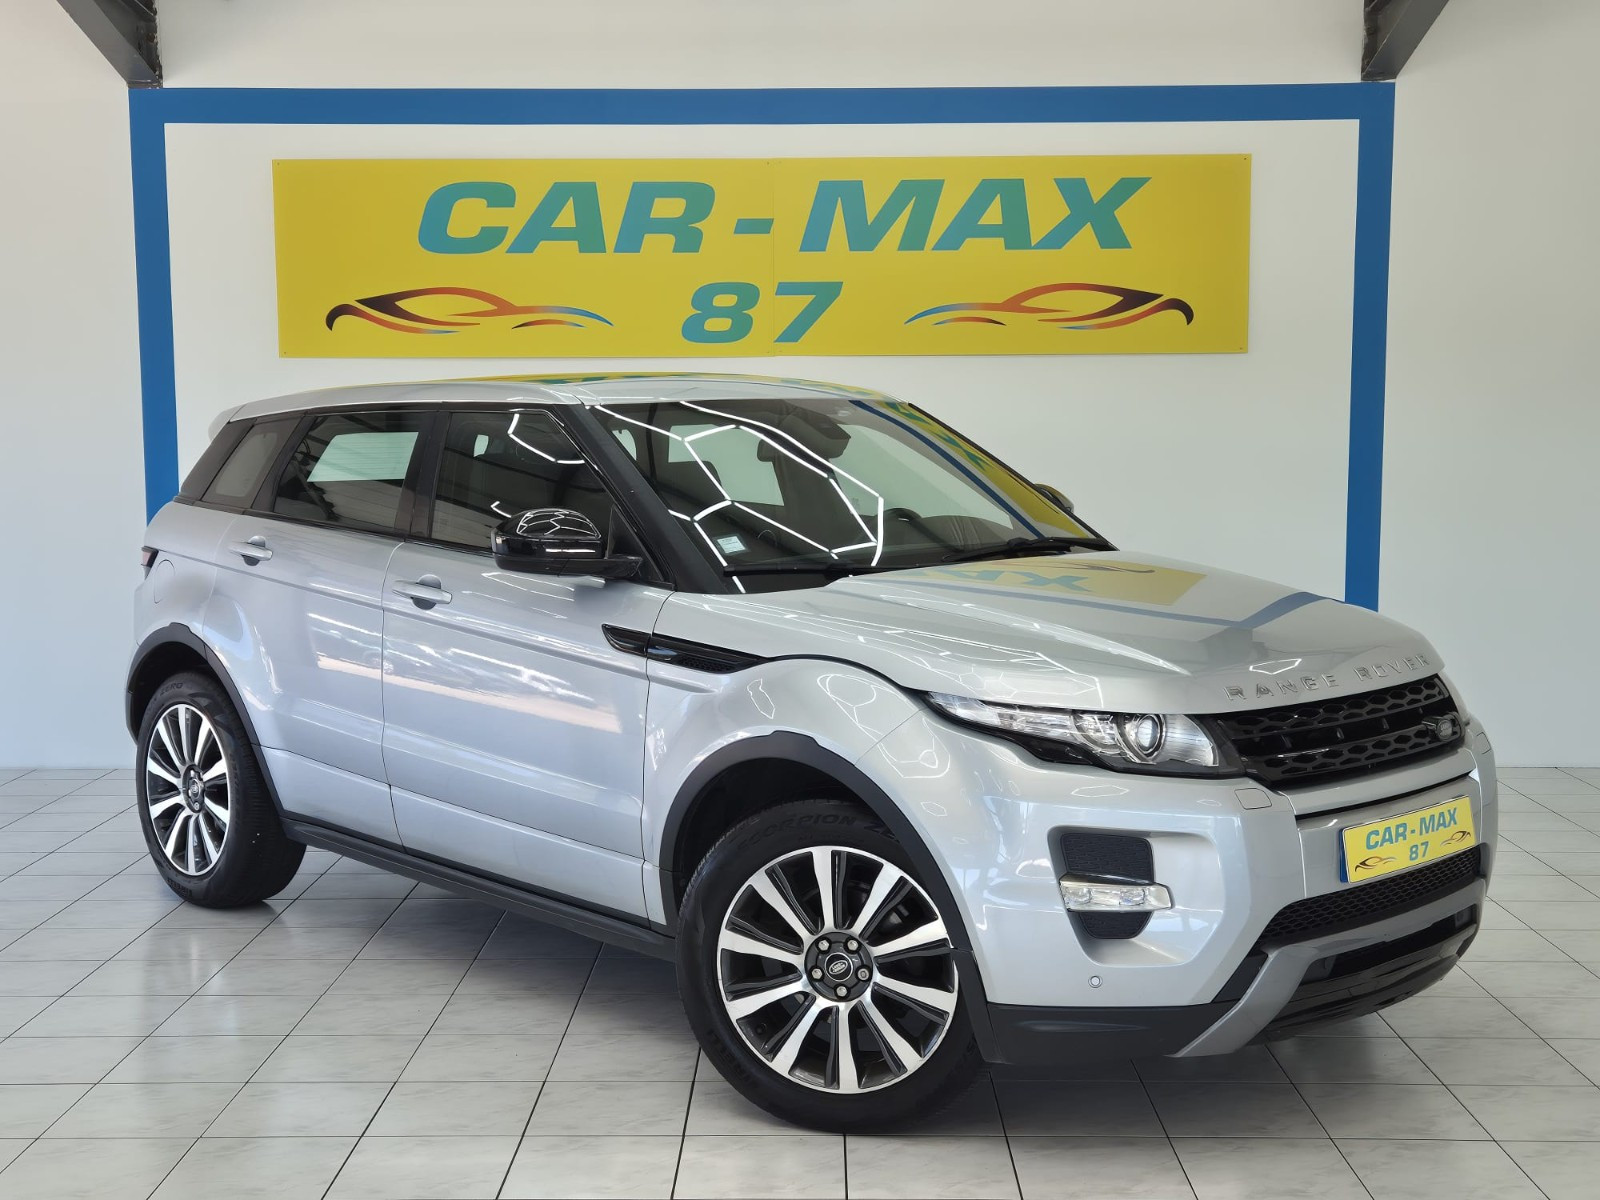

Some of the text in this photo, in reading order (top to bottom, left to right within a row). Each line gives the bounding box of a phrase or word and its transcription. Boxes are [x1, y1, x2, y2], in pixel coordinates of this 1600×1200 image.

[681, 281, 844, 344] 87
[1223, 654, 1430, 701] RANGE ROVER
[1409, 840, 1430, 862] 87
